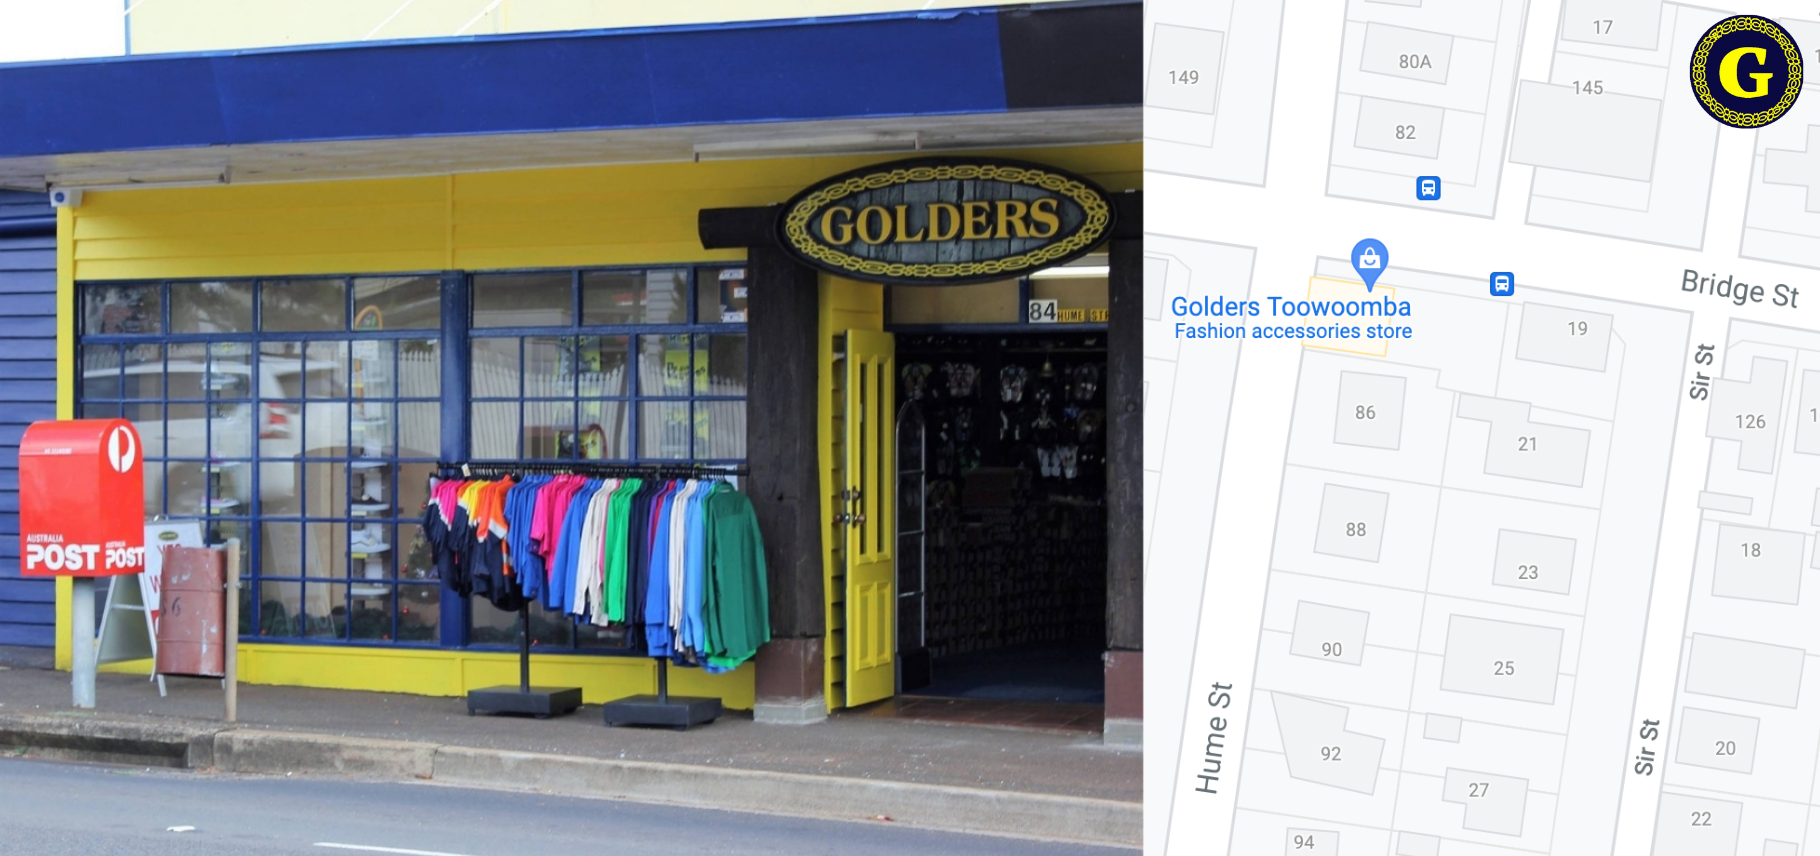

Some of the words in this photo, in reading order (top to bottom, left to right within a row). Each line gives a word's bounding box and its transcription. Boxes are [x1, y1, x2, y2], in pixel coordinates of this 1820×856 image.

[820, 198, 1060, 245] GOLDERS
[1030, 301, 1056, 321] 84
[1057, 310, 1083, 322] HUME
[27, 533, 64, 543] AUSTRALIA
[26, 543, 101, 570] POST
[105, 546, 145, 570] POST
